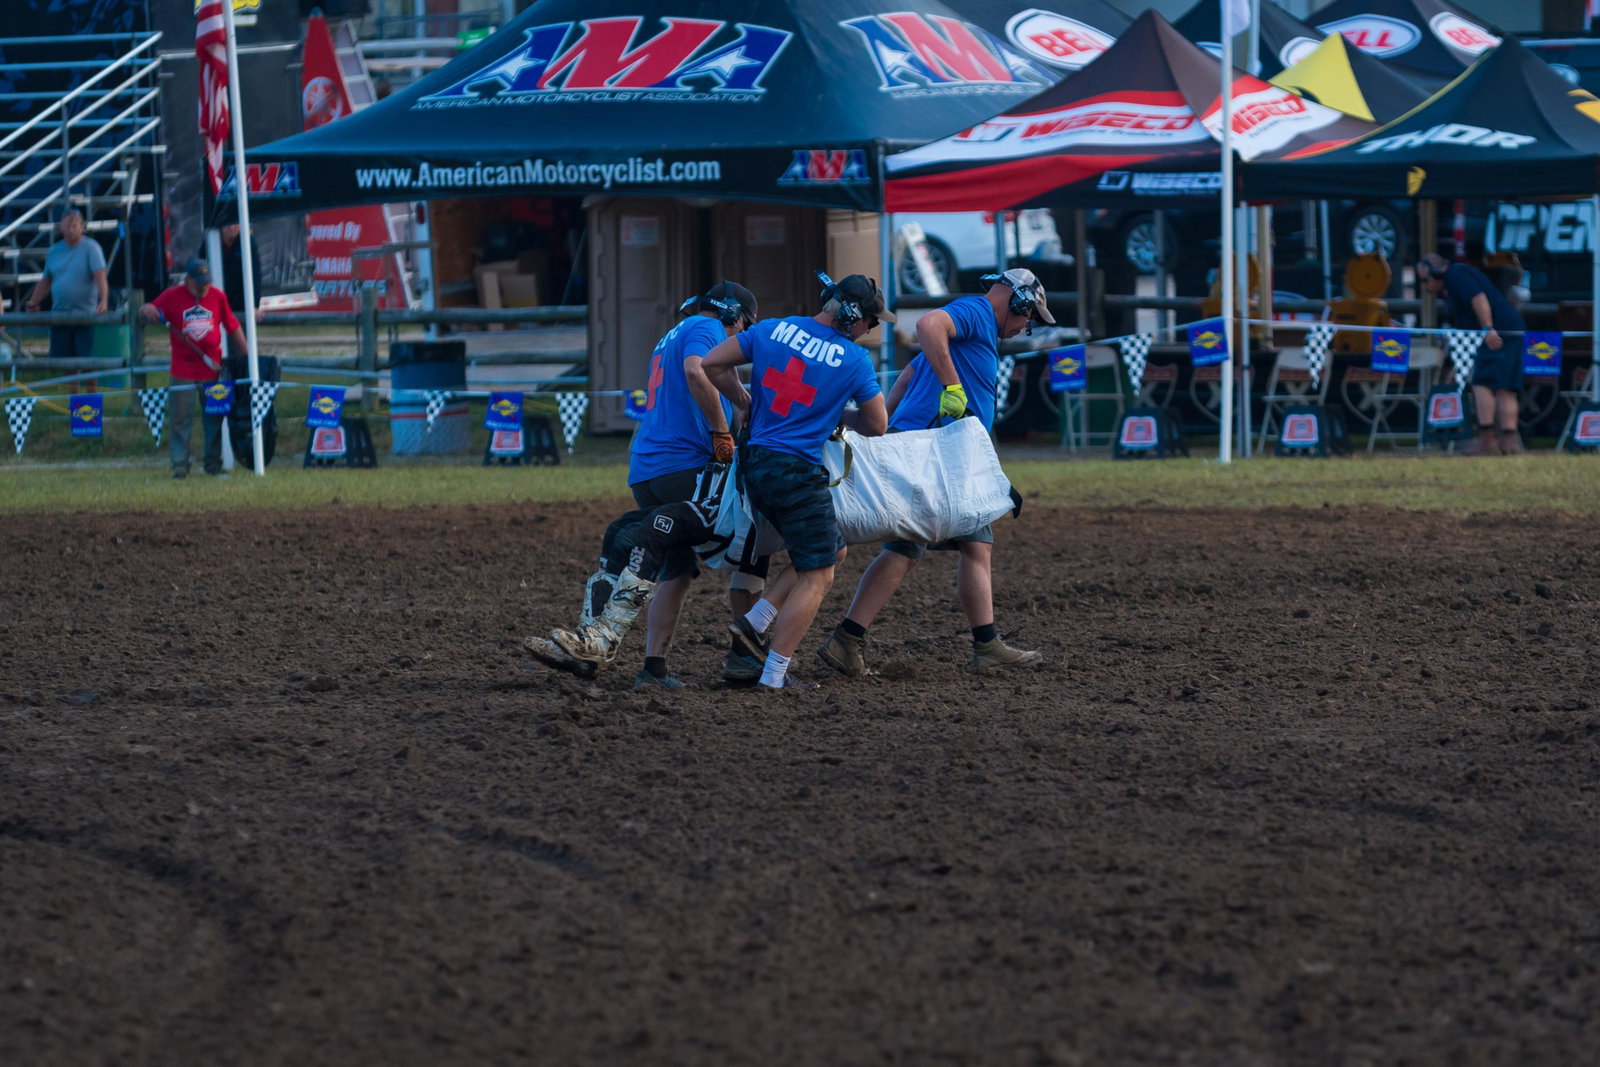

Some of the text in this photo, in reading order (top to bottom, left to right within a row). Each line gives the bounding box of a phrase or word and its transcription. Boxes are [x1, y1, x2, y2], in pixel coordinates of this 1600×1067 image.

[416, 15, 794, 101] AMA
[410, 91, 761, 110] AMERICAN MOTORCYCLIST ASSOCIATION
[1354, 123, 1538, 155] THOR
[355, 158, 722, 190] www.AmericanMotorcyclist.com
[777, 149, 871, 184] AMA
[769, 320, 845, 368] MEDIC
[628, 546, 646, 576] USE
